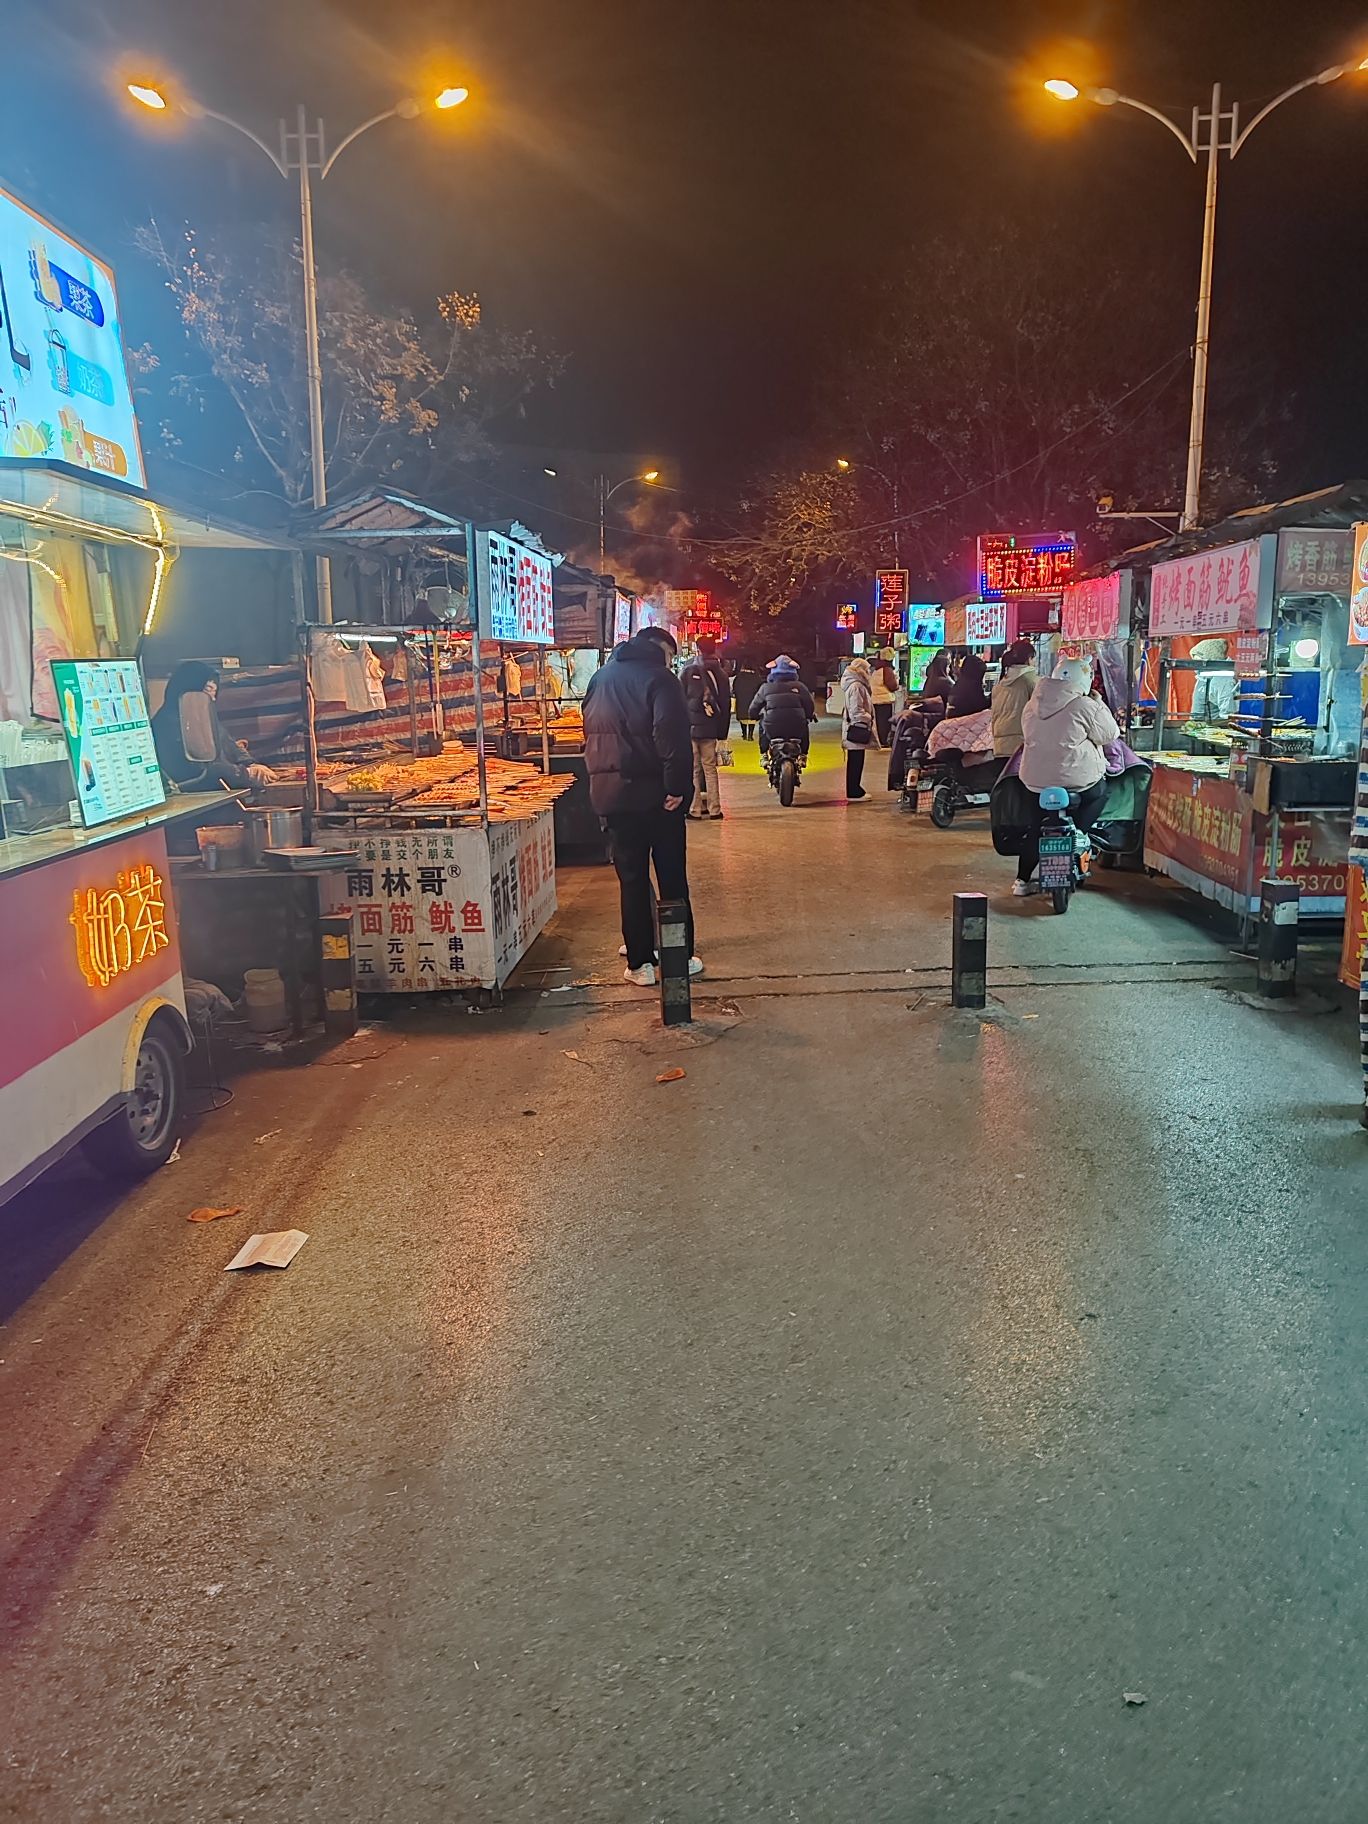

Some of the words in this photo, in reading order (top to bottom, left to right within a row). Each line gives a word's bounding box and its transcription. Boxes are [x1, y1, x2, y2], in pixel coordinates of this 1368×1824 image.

[1168, 547, 1257, 617] 烤面筋鱿鱼
[880, 574, 904, 630] 莲子粥
[352, 848, 455, 861] 要是交个朋友
[1260, 874, 1345, 891] 5370
[79, 865, 169, 986] 奶茶
[357, 936, 464, 954] 一元一串
[357, 956, 465, 974] 五元六串
